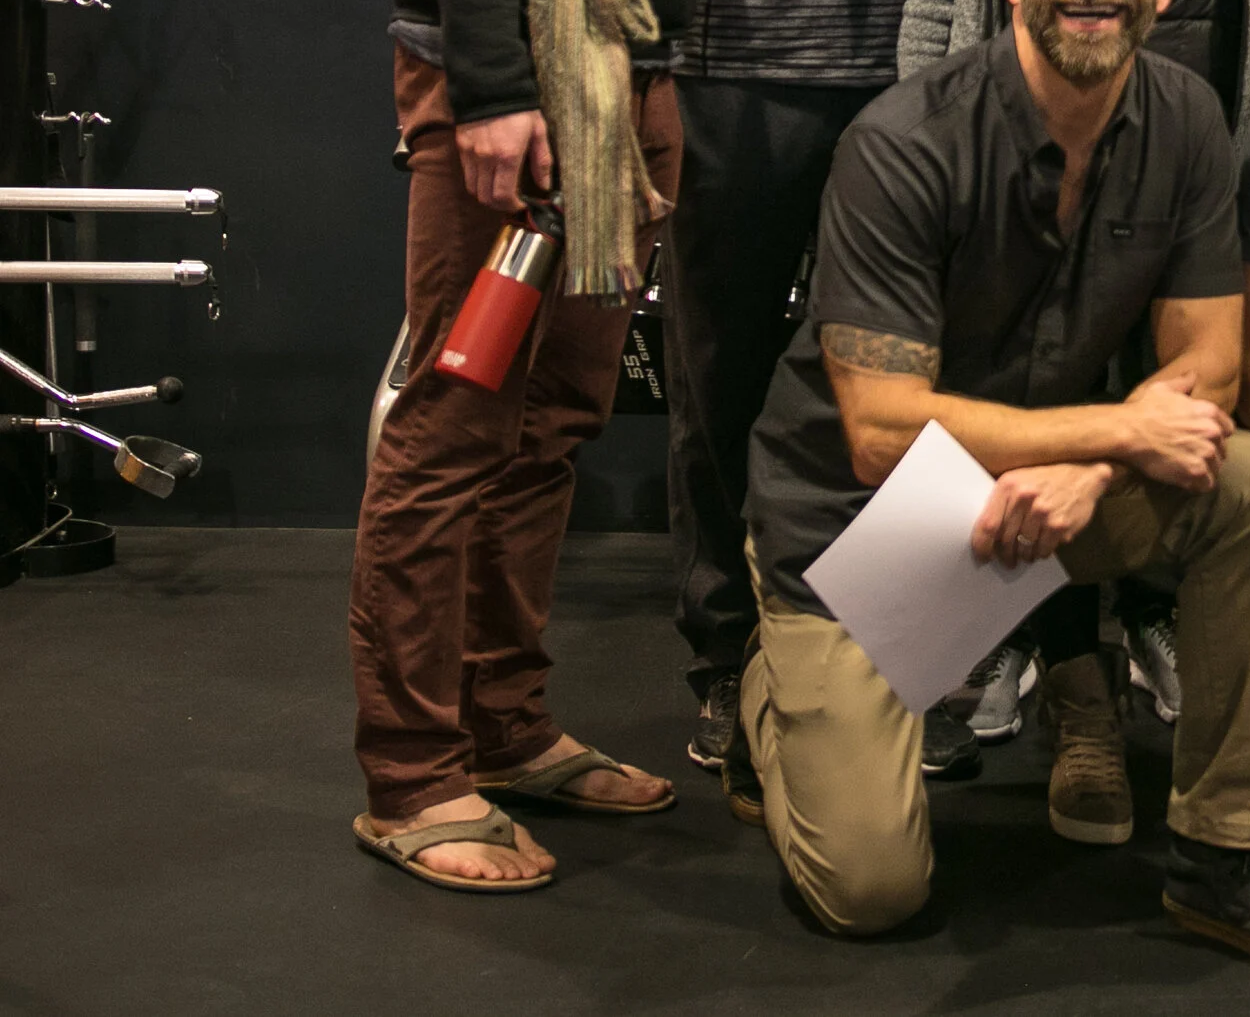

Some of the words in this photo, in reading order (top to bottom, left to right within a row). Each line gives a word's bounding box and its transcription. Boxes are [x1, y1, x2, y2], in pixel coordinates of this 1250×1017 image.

[632, 329, 650, 361] GRIP
[622, 355, 645, 379] 55
[644, 368, 663, 399] IRON
